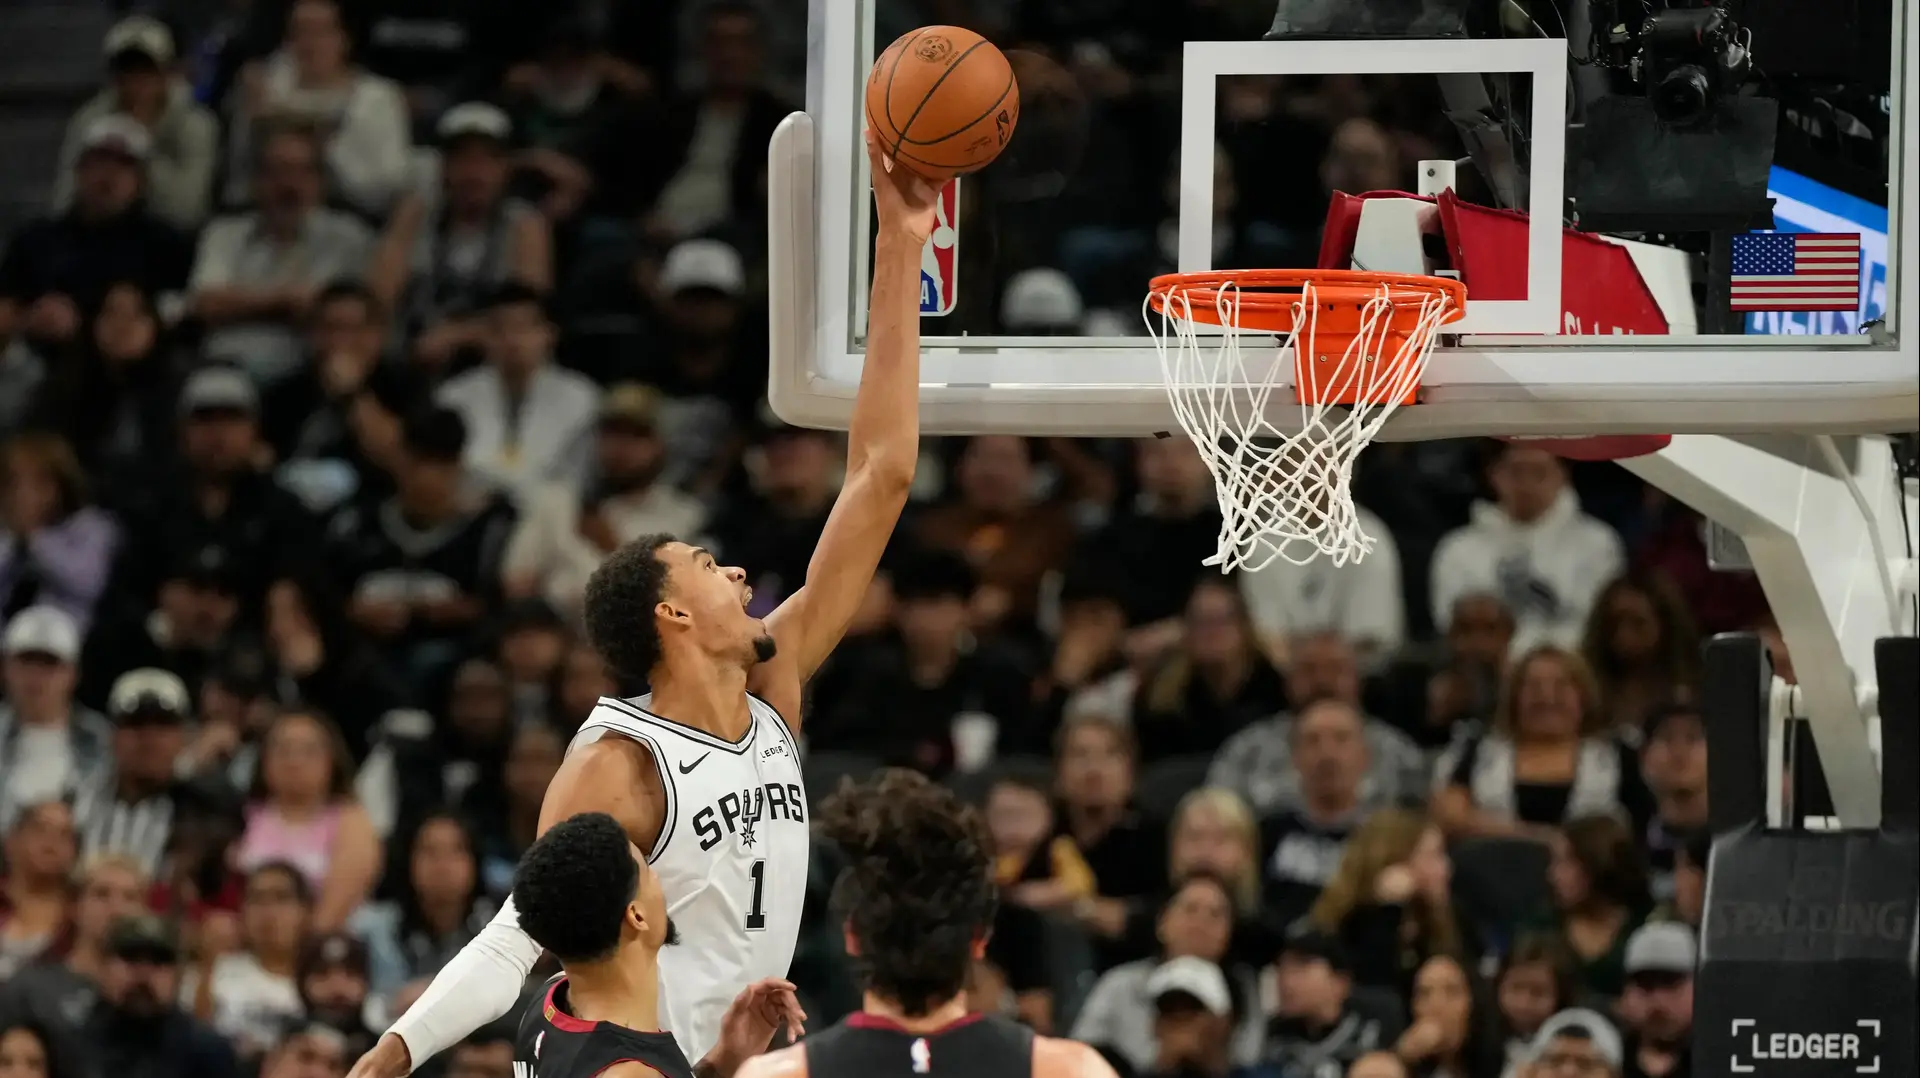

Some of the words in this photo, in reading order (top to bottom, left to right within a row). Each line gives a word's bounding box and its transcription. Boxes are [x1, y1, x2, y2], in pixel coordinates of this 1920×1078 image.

[692, 782, 804, 852] SPURS
[744, 858, 767, 932] 1
[1752, 1033, 1860, 1059] LEDGER
